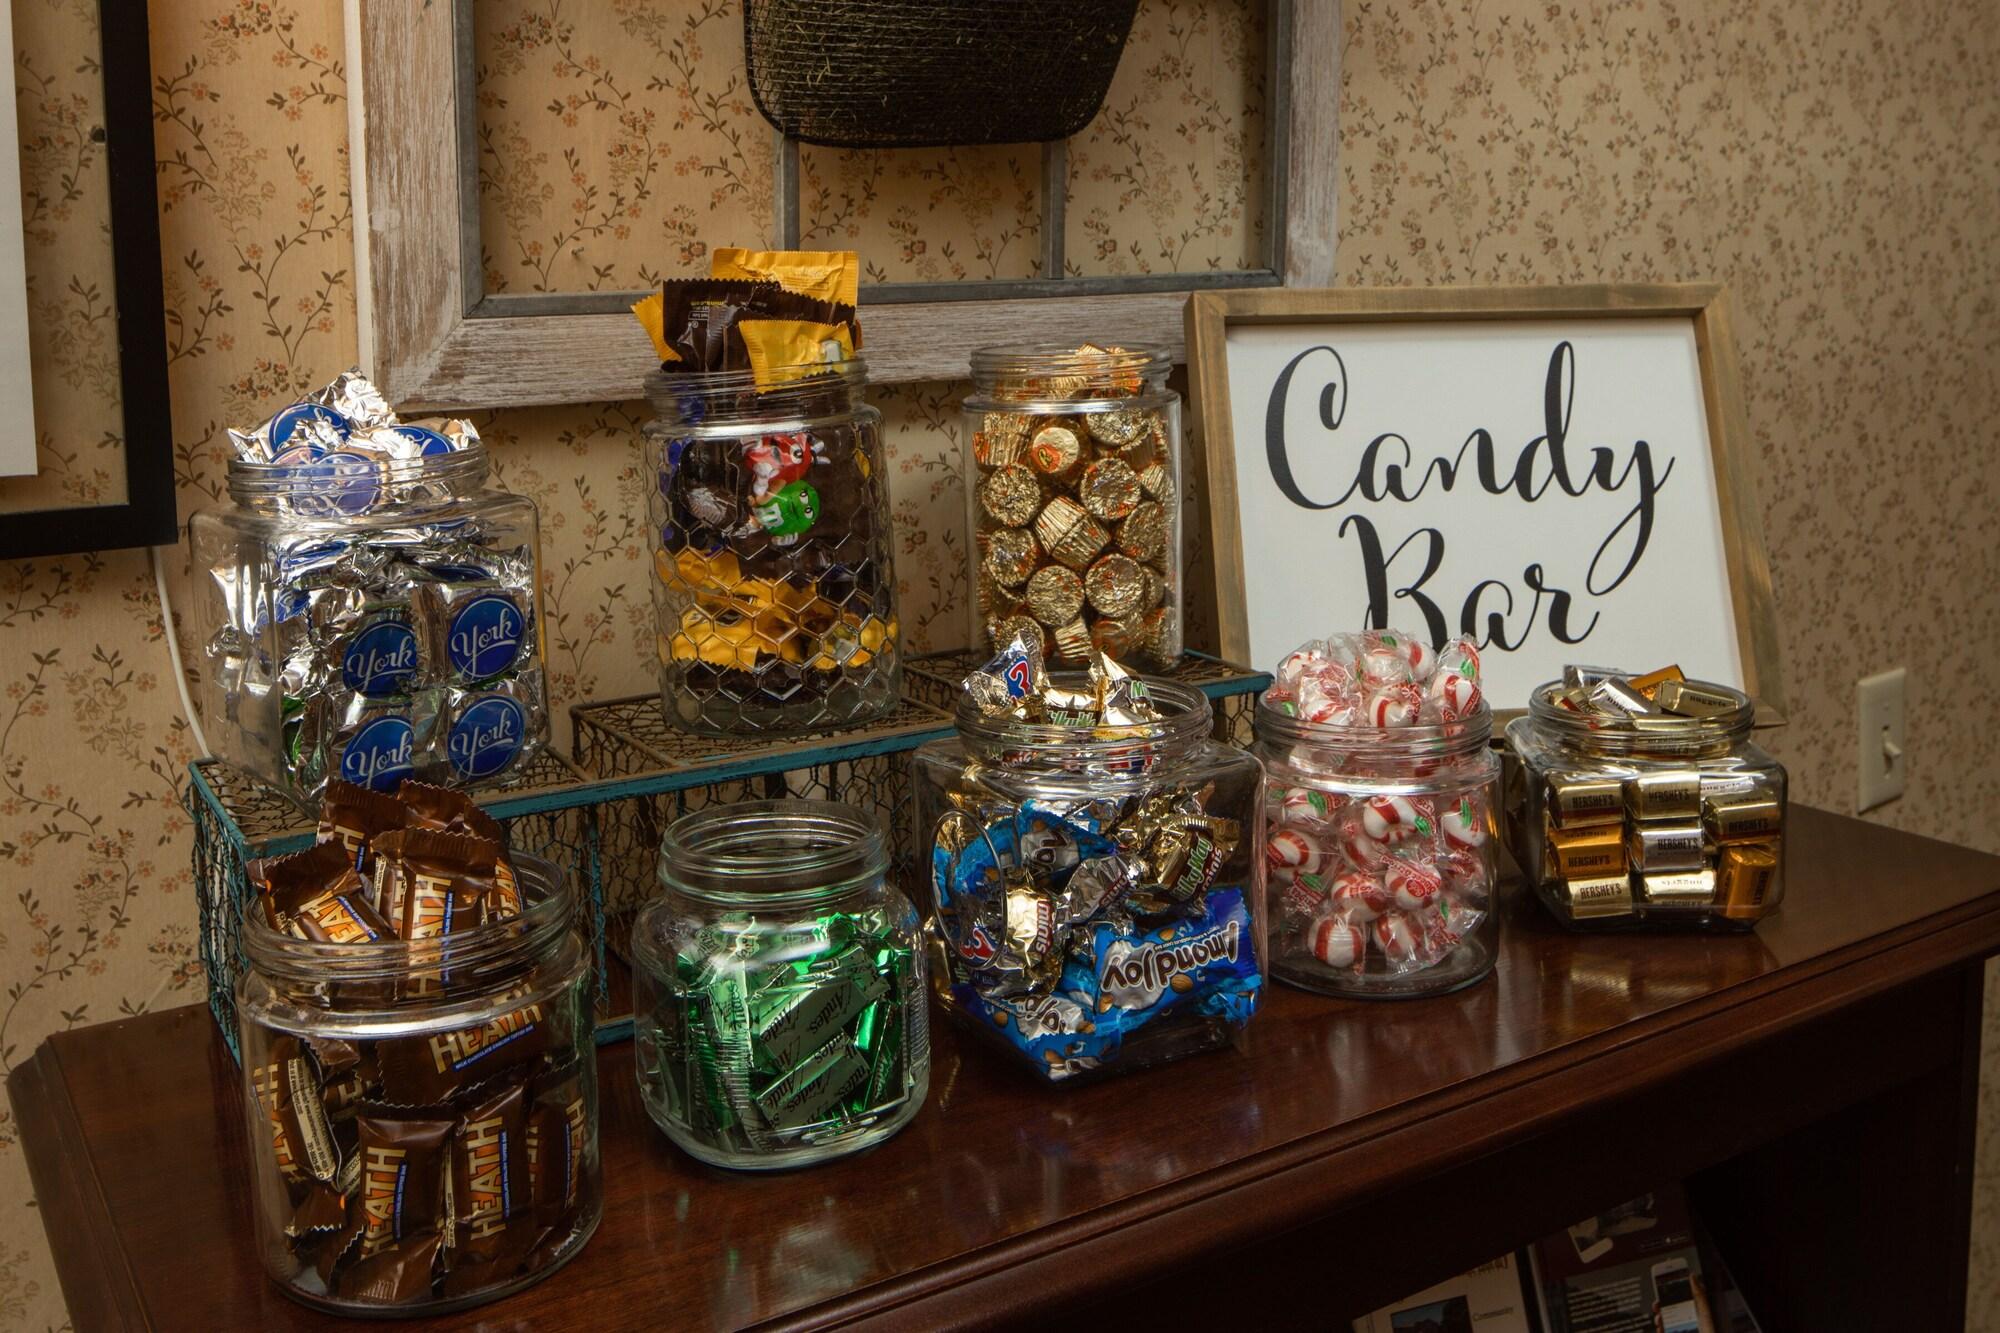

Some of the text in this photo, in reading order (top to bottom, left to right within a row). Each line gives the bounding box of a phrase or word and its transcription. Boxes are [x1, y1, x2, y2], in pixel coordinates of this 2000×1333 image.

[1265, 340, 1676, 596] Candy
[1338, 513, 1600, 652] Bar
[346, 634, 416, 691] York
[451, 606, 519, 681] York
[345, 729, 413, 789] York
[450, 706, 514, 782] York
[1579, 882, 1622, 900] HERSHEY'S
[1036, 902, 1049, 954] minis
[1100, 947, 1156, 992] Joy
[428, 1004, 543, 1074] HEATH
[808, 984, 846, 1035] Andes
[839, 1064, 867, 1098] ndes
[360, 1146, 407, 1260] HEATH
[466, 1116, 507, 1241] HEATH
